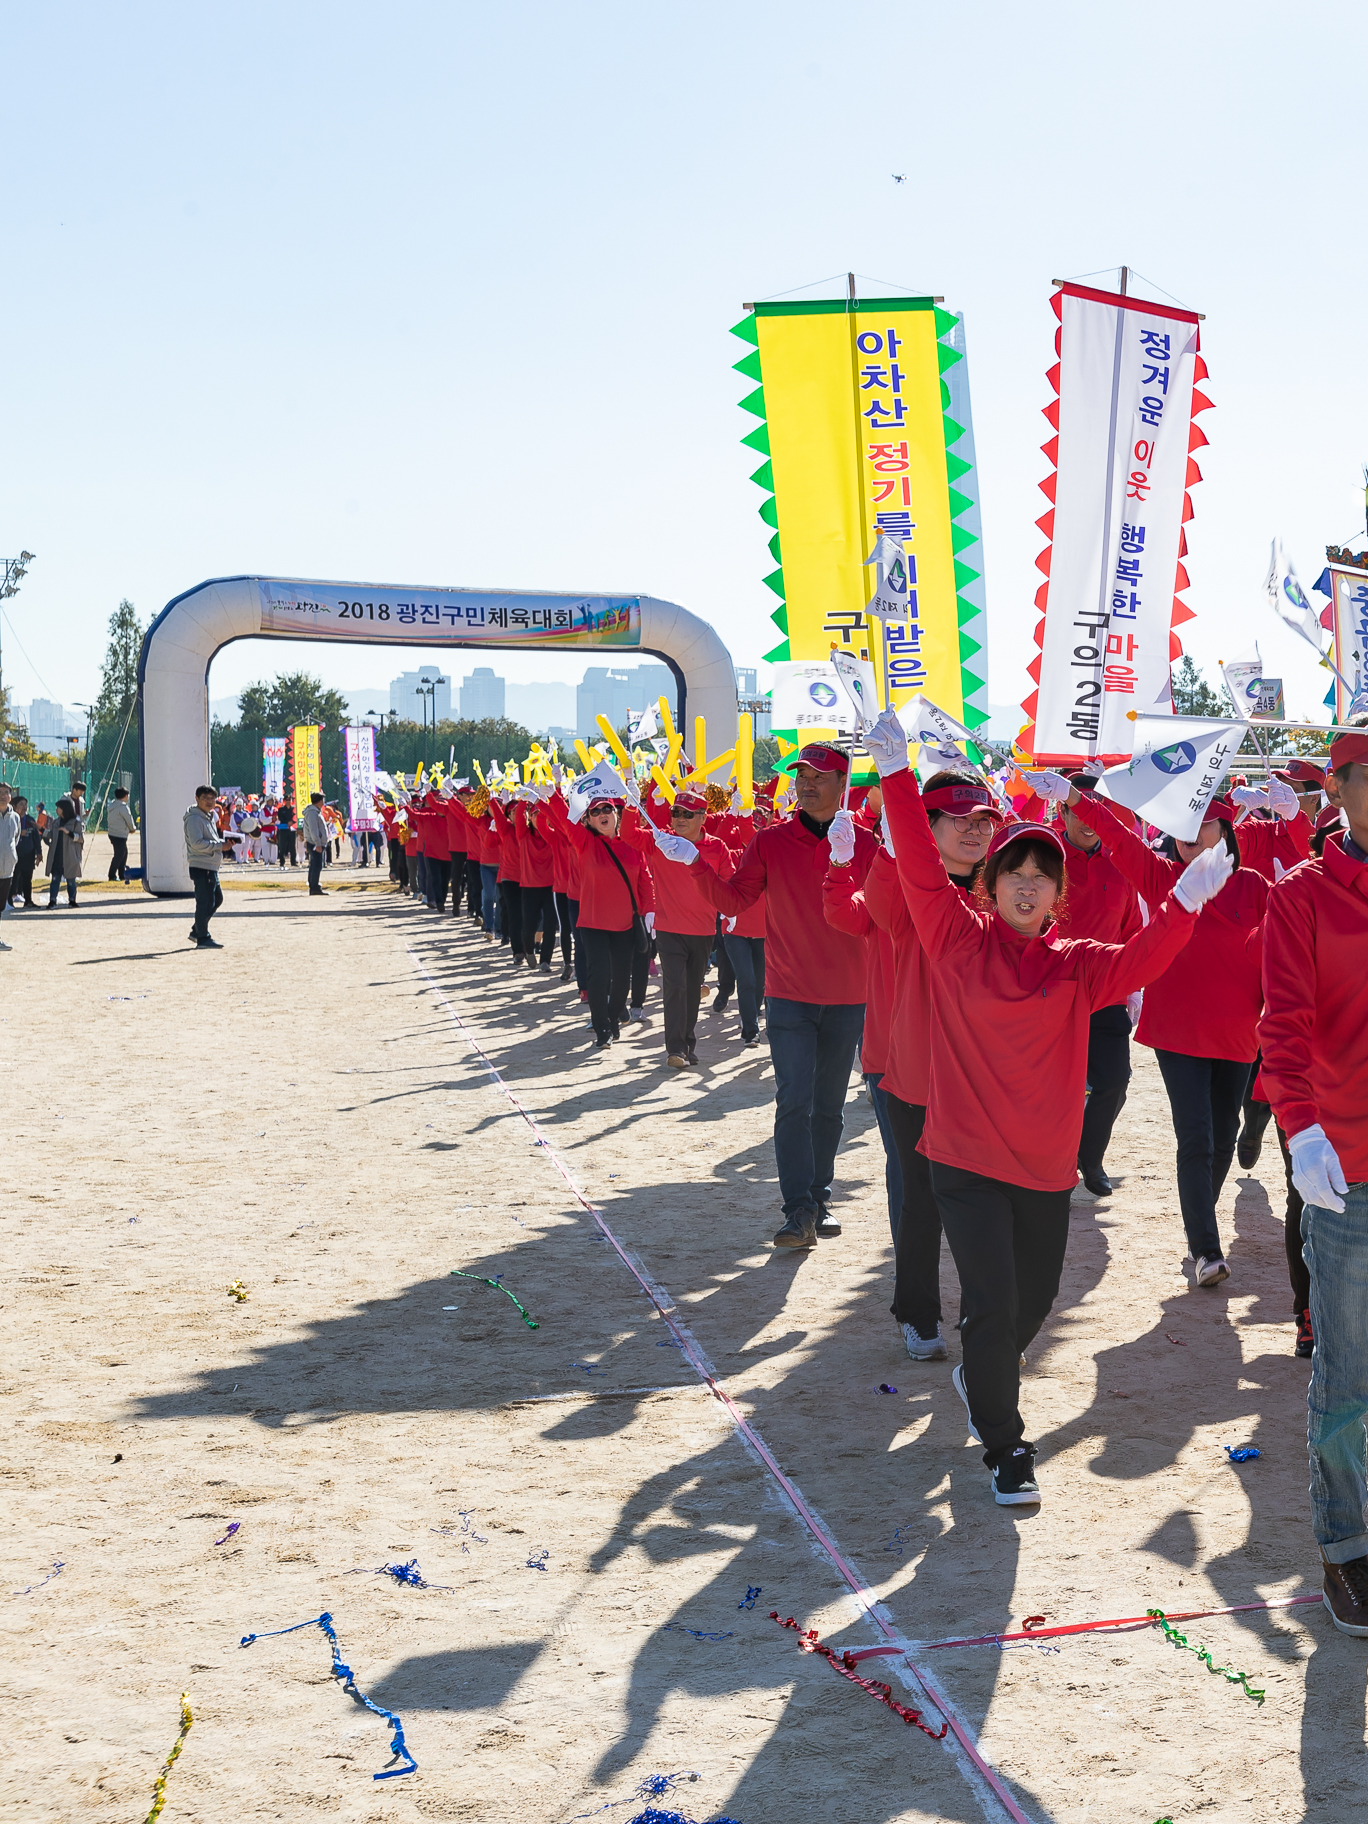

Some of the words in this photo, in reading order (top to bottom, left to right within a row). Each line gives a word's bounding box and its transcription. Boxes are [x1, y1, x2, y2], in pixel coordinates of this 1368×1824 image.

[857, 328, 908, 428] 아차산
[1138, 329, 1171, 427] 정겨운
[867, 442, 916, 541] 정기를
[1126, 439, 1156, 502] 이웃
[337, 601, 391, 621] 2018
[1111, 522, 1146, 620] 행복한
[1066, 610, 1111, 741] 구의2동
[1103, 633, 1139, 694] 마을
[1252, 696, 1276, 712] 곡4동
[953, 788, 988, 803] 구의2동
